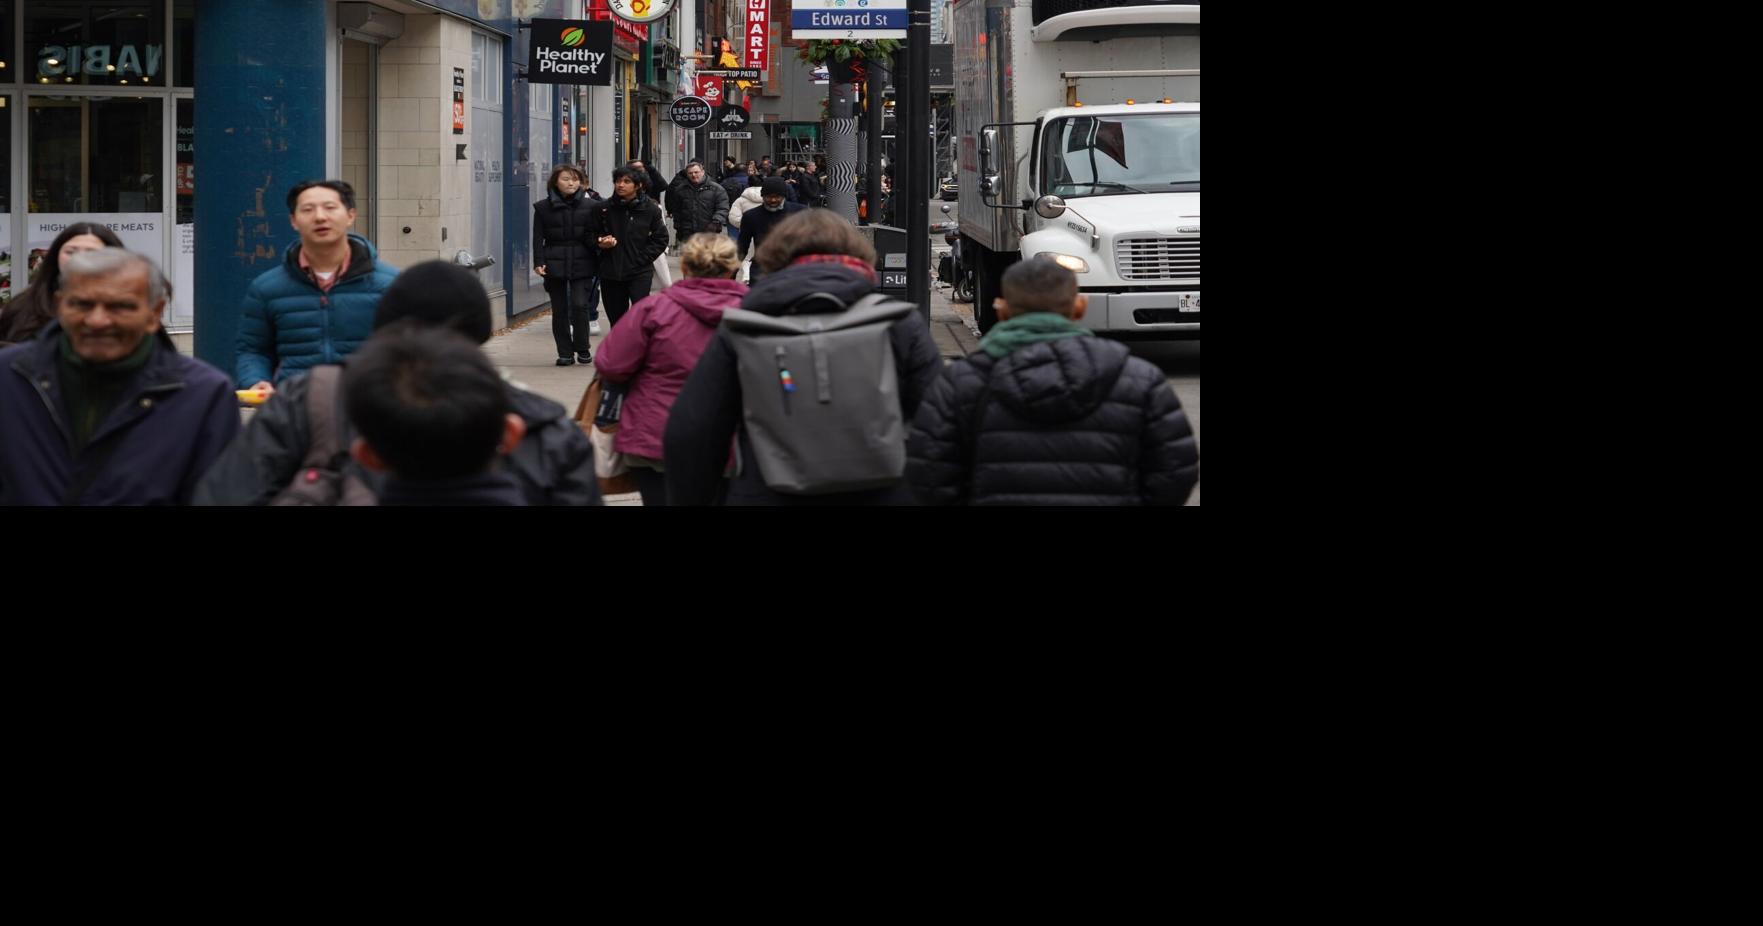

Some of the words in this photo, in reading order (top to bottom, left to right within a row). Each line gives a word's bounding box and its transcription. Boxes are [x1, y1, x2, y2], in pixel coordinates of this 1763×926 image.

[812, 12, 870, 25] Edward
[875, 14, 887, 25] St
[750, 11, 764, 59] MART
[536, 46, 605, 64] Healthy
[540, 59, 597, 74] Planet
[672, 106, 708, 114] ESCAPE
[121, 223, 154, 231] MEATS
